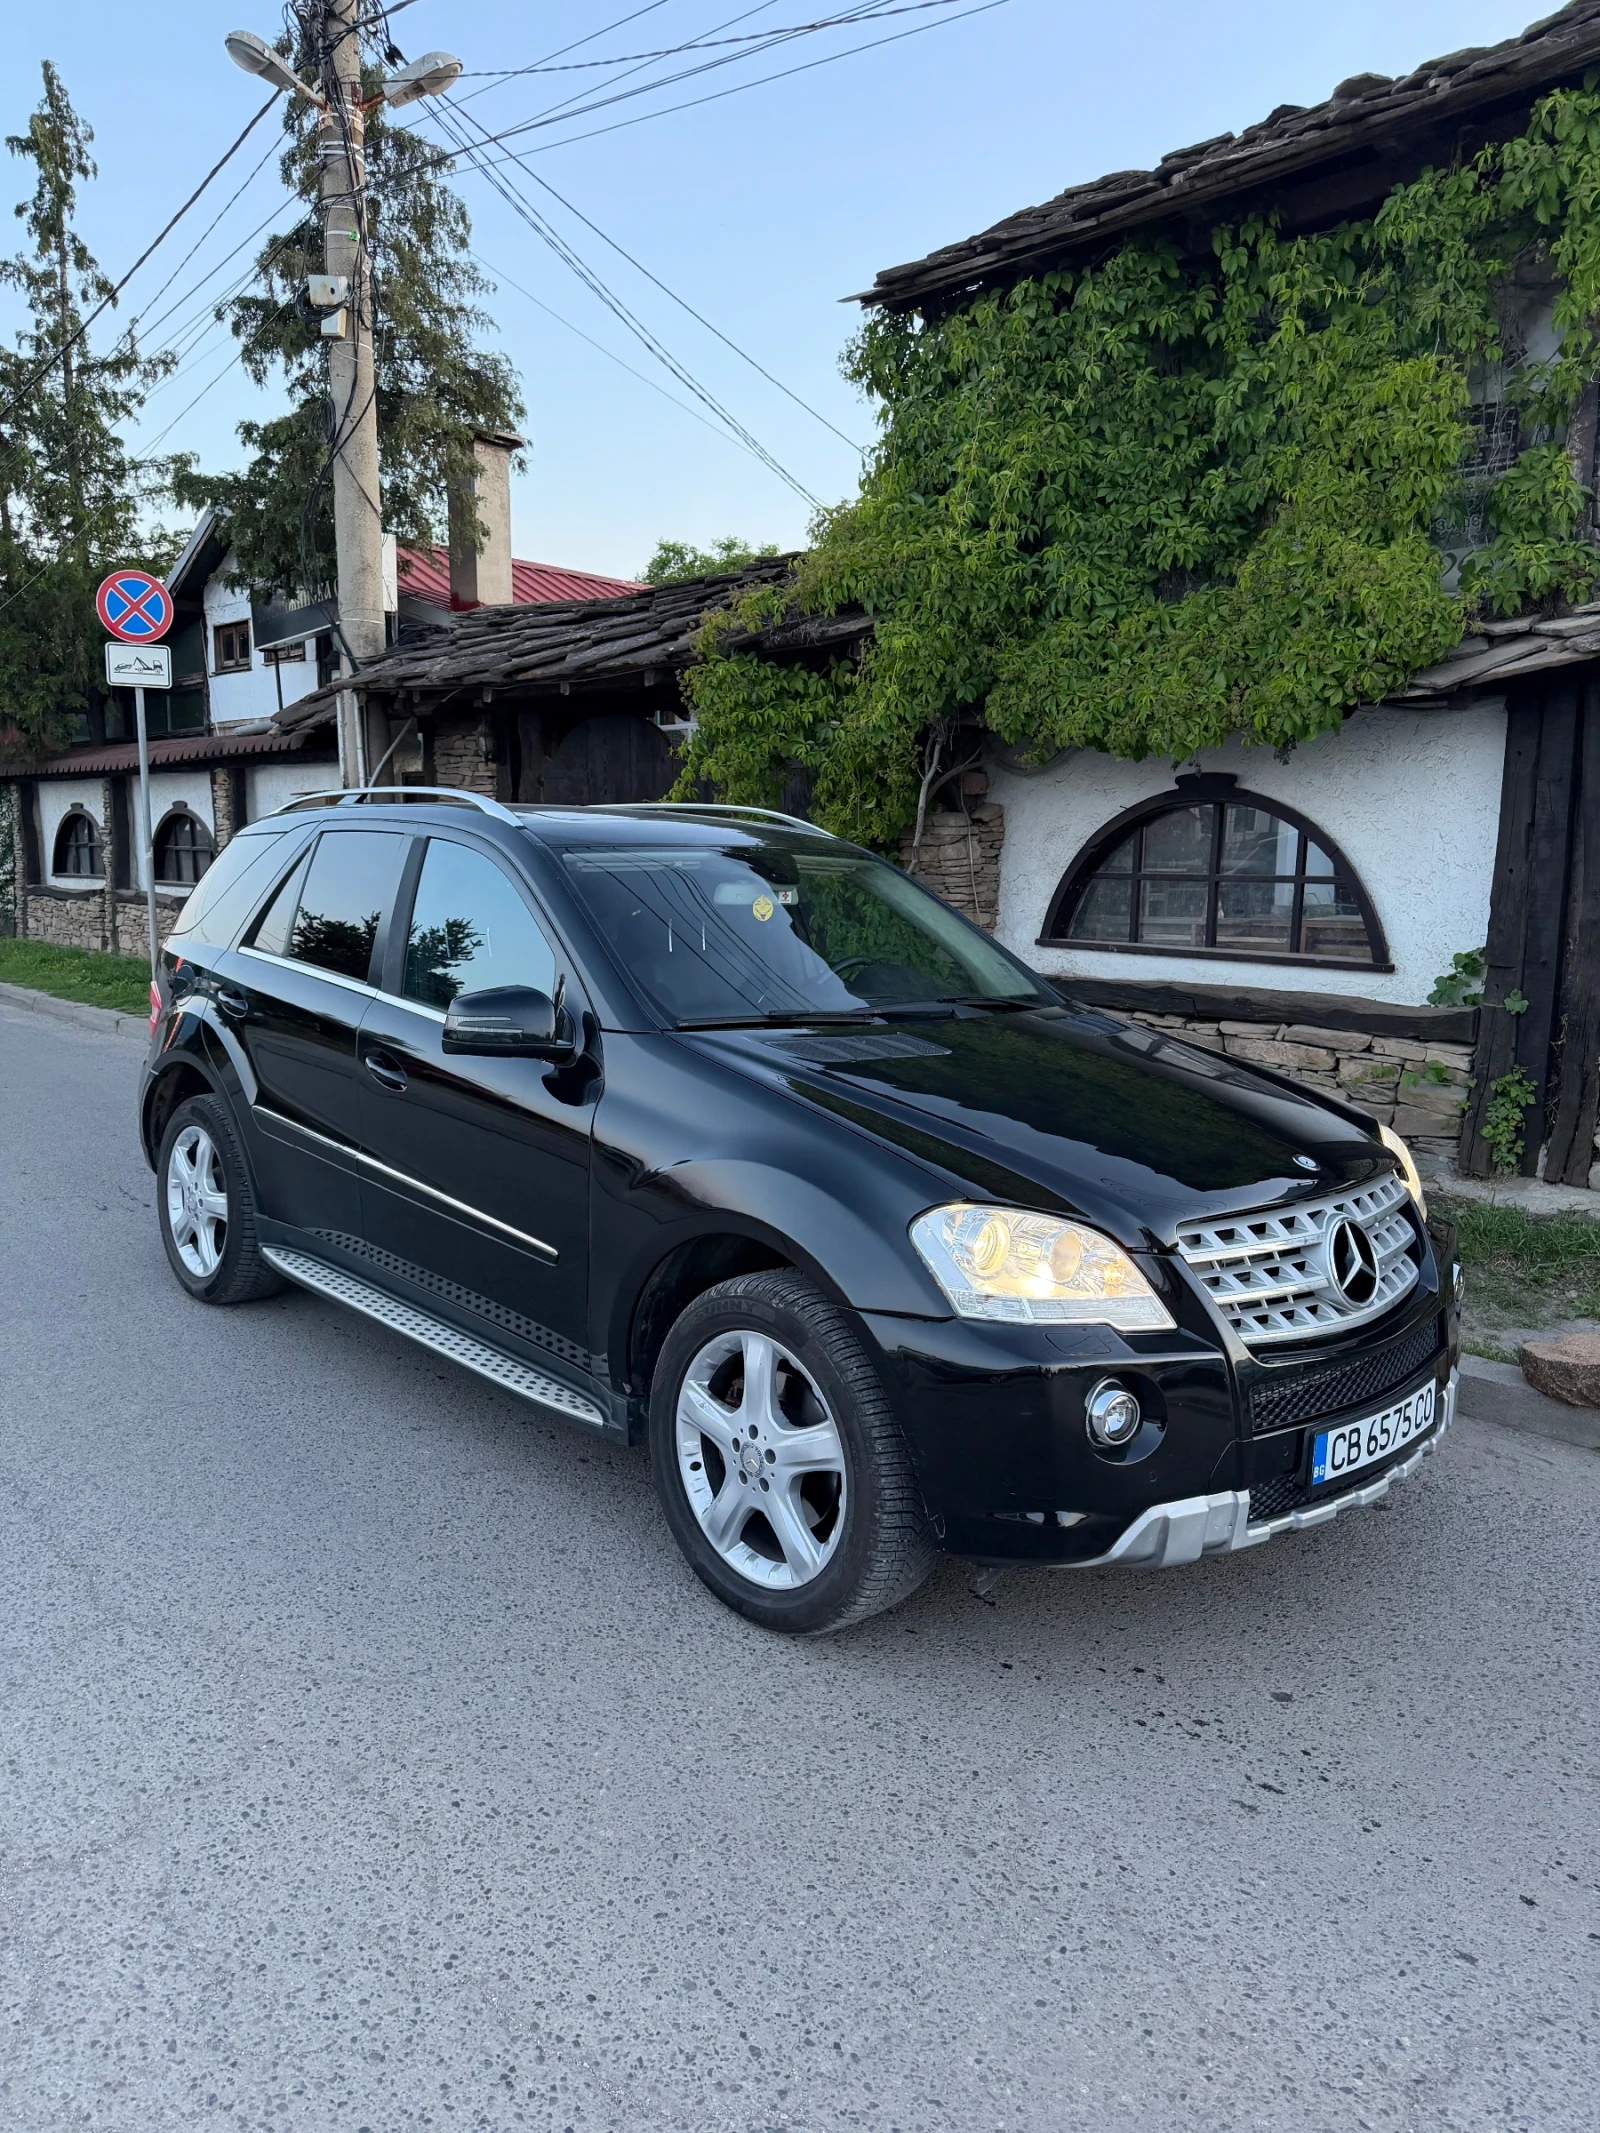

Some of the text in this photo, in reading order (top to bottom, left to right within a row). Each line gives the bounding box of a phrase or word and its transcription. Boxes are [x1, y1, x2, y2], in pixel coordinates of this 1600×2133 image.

[1332, 1387, 1433, 1471] CB 6575 CO
[1314, 1464, 1325, 1478] BG
